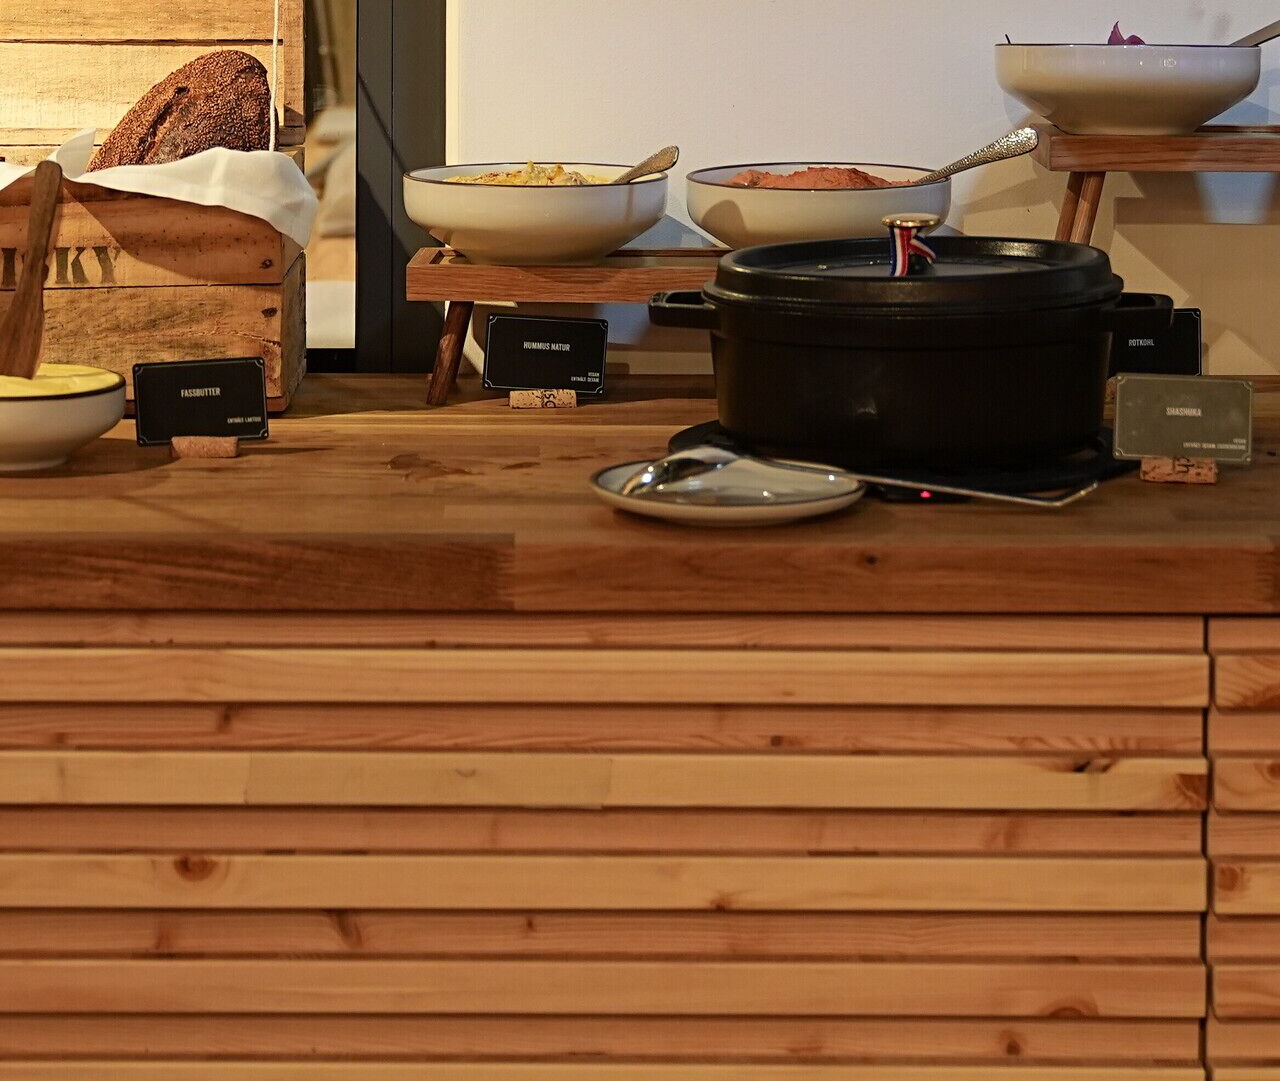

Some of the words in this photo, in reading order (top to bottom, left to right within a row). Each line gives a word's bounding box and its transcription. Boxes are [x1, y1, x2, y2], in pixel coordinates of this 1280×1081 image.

[523, 341, 550, 351] HUMMUS
[551, 343, 571, 352] NATUR
[1128, 338, 1155, 347] ROTKOHL
[180, 387, 221, 398] FASSBUTTER
